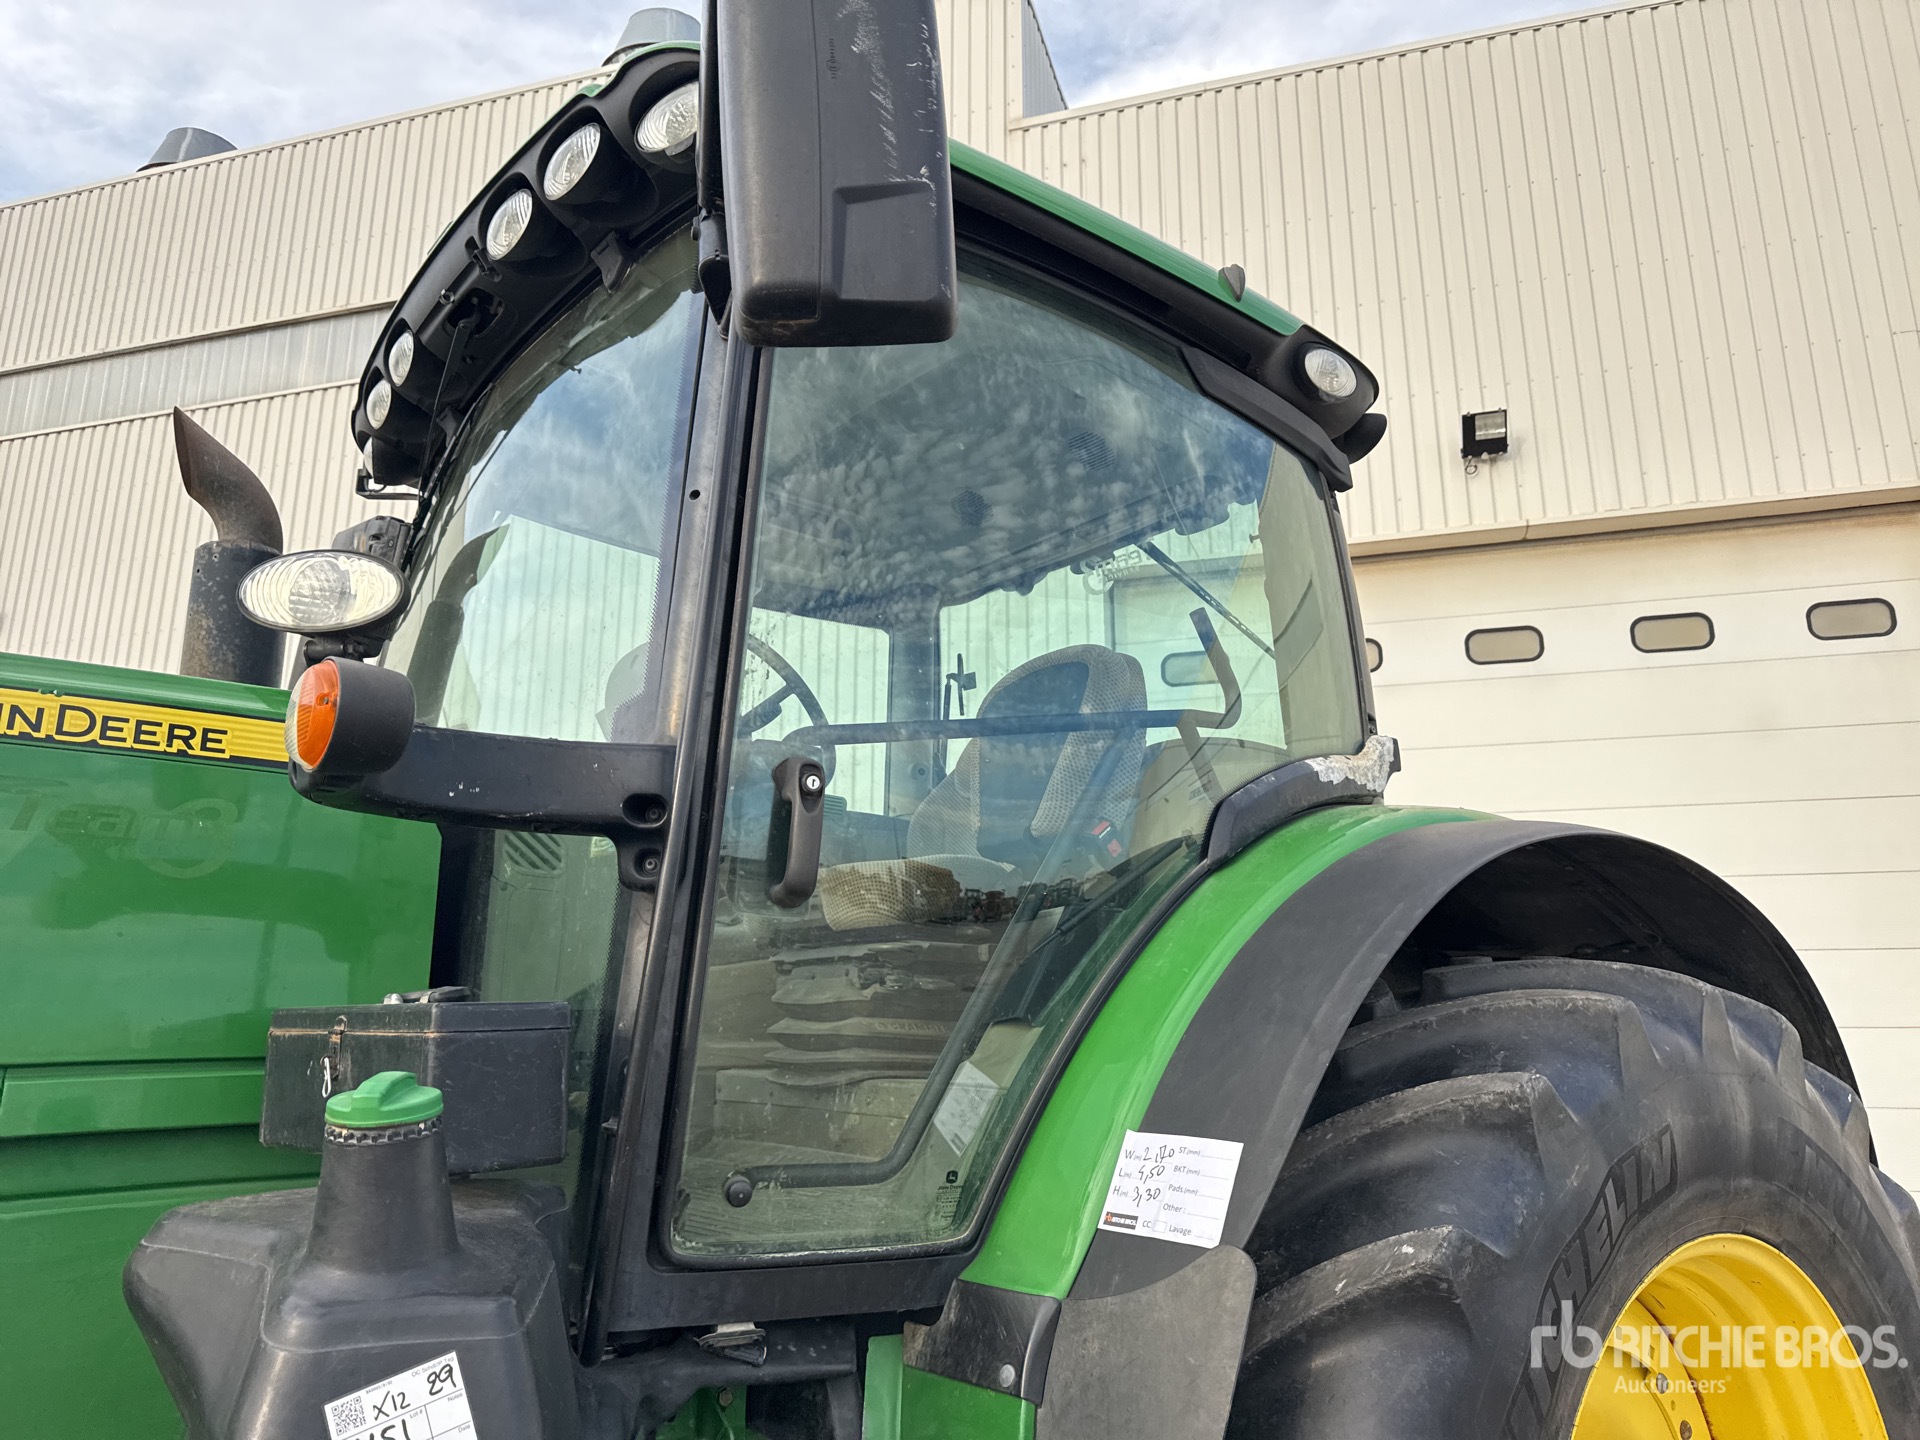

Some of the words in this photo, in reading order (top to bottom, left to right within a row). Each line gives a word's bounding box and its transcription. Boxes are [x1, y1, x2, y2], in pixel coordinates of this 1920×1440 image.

[0, 702, 46, 735] N
[55, 703, 229, 754] DEERE
[447, 1392, 464, 1403] Notes
[457, 1423, 471, 1434] Date
